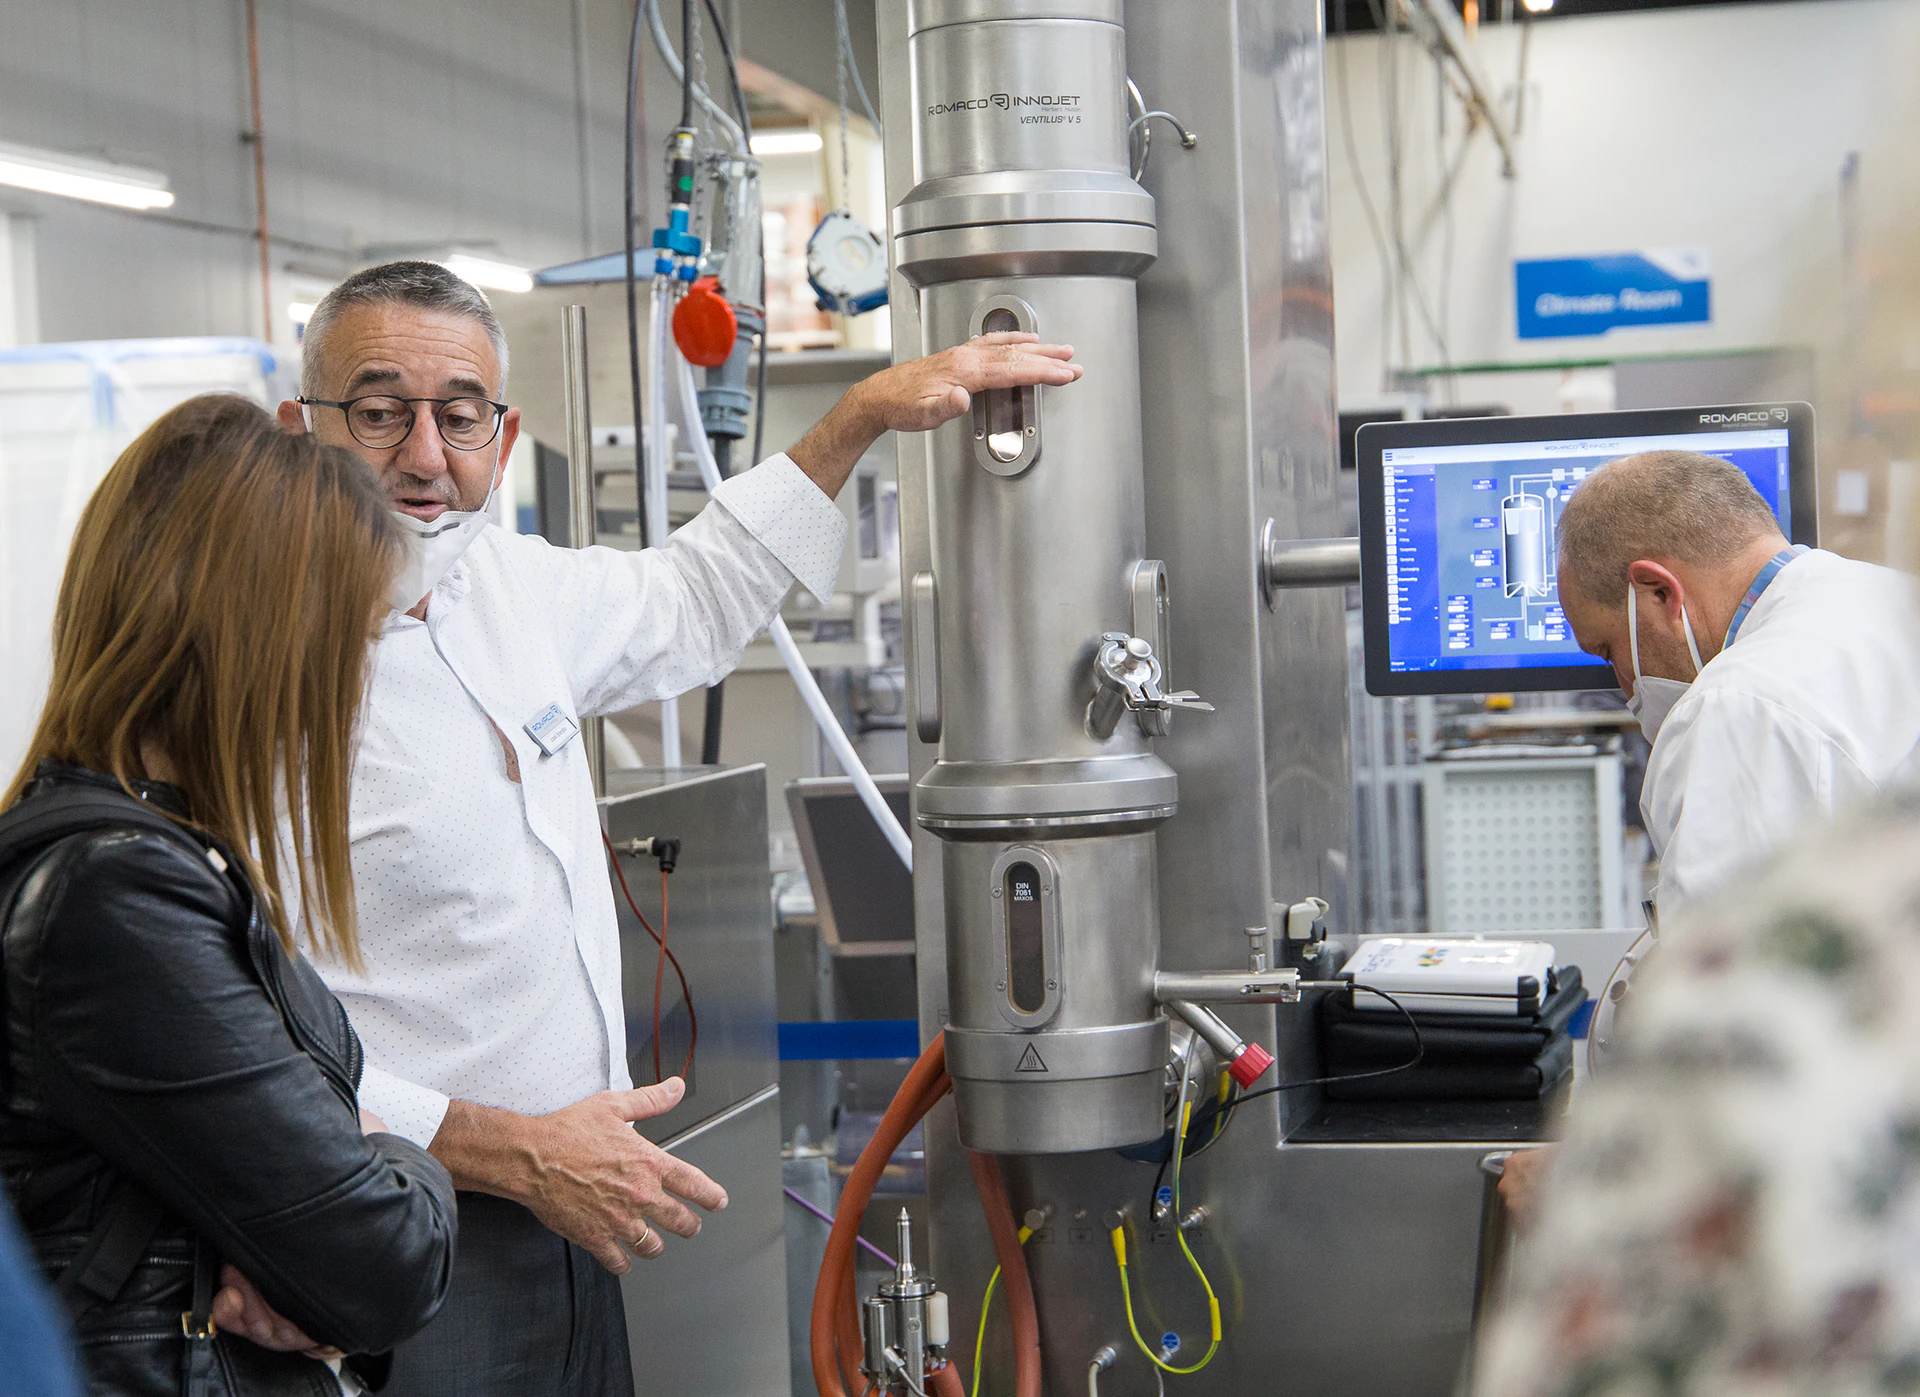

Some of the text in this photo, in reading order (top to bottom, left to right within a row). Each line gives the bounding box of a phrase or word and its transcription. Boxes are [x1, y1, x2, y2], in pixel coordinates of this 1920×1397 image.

[927, 95, 1081, 116] ROMACO INNOJET
[1068, 115, 1075, 124] V
[1075, 115, 1082, 124] 5
[1535, 288, 1683, 317] Climate Room
[1699, 411, 1769, 424] ROMACO
